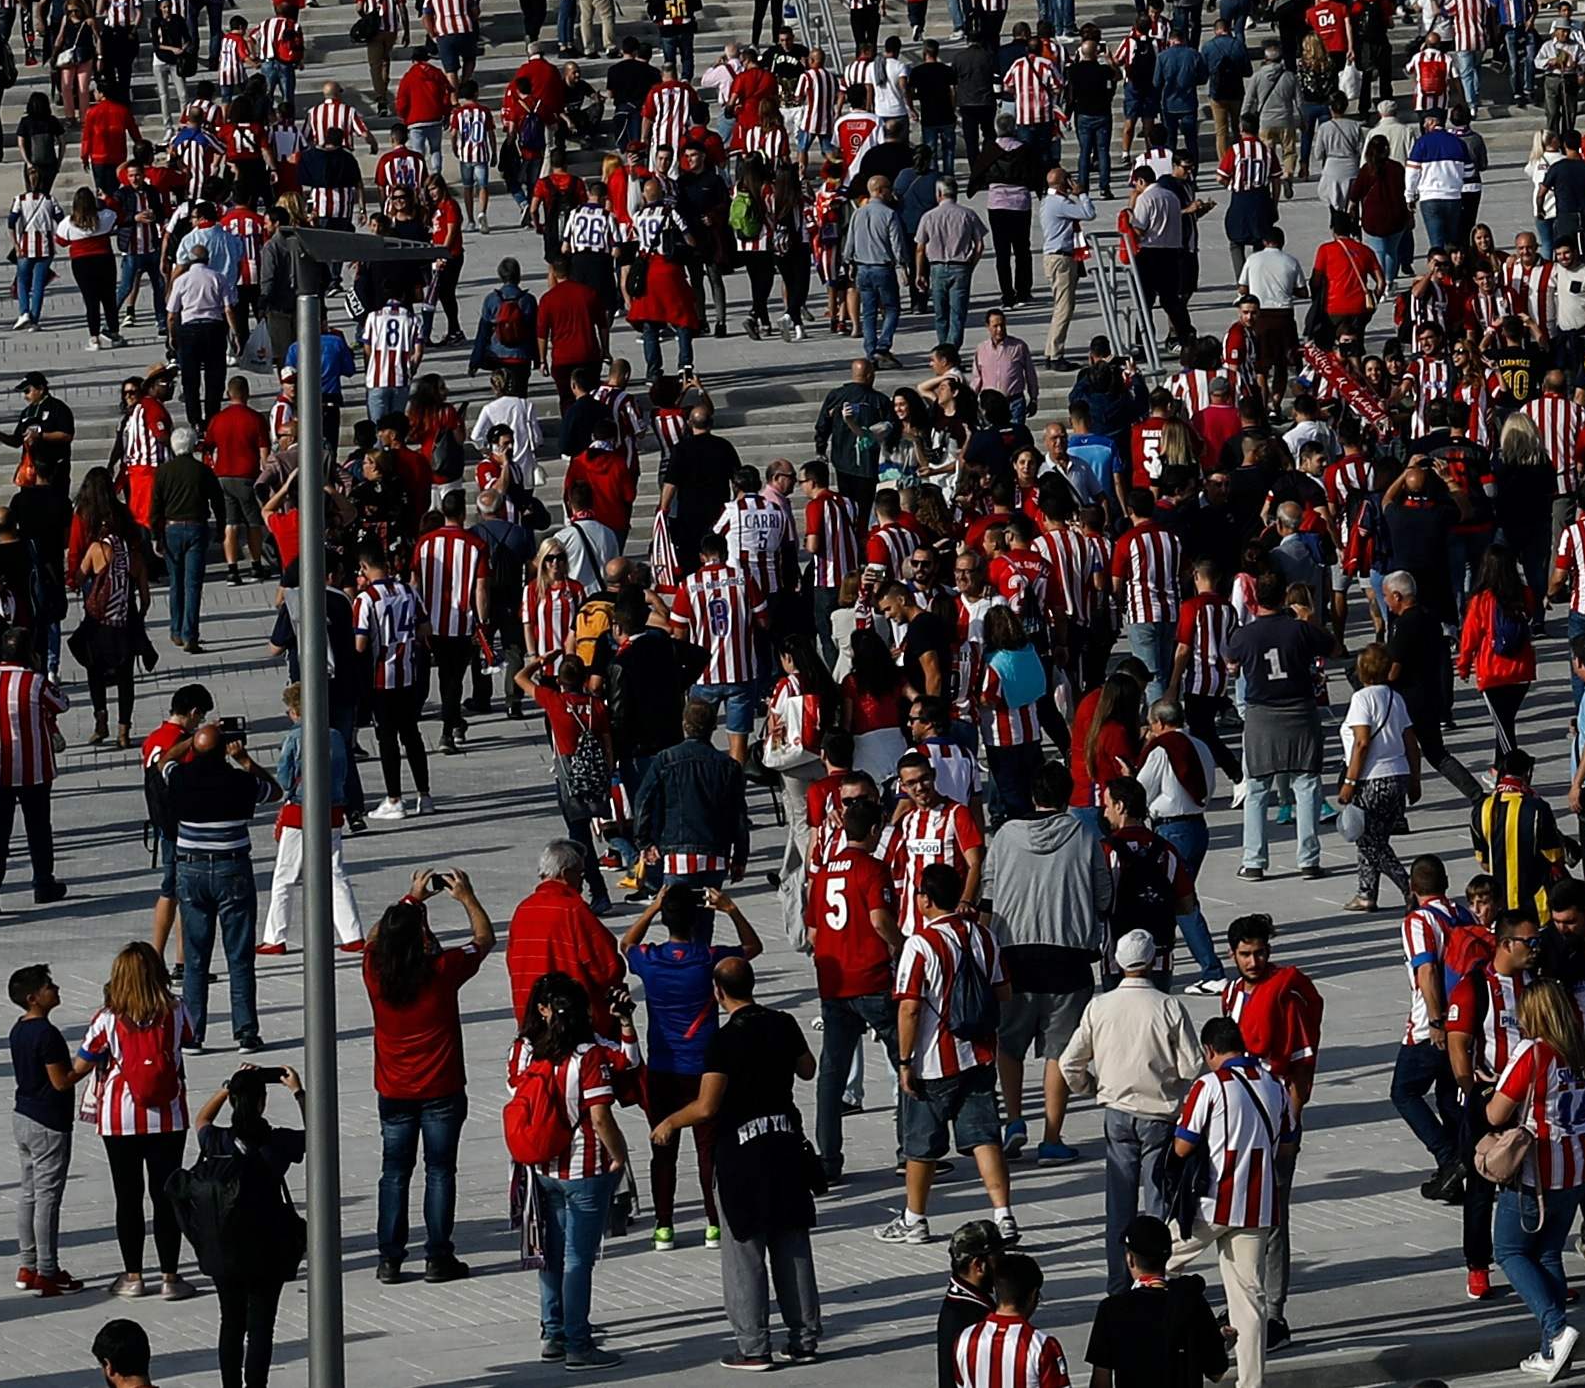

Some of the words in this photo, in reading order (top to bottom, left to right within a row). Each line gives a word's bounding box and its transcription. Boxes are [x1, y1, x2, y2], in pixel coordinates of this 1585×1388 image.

[1318, 13, 1335, 28] 04
[575, 215, 605, 245] 26
[639, 219, 658, 244] 19
[387, 319, 400, 348] 8
[1143, 438, 1163, 480] 5
[759, 530, 768, 550] 5
[383, 600, 416, 644] 14
[1264, 648, 1288, 681] 1
[827, 859, 852, 873] TIAGO
[825, 876, 848, 931] 5
[737, 1116, 768, 1146] NEW
